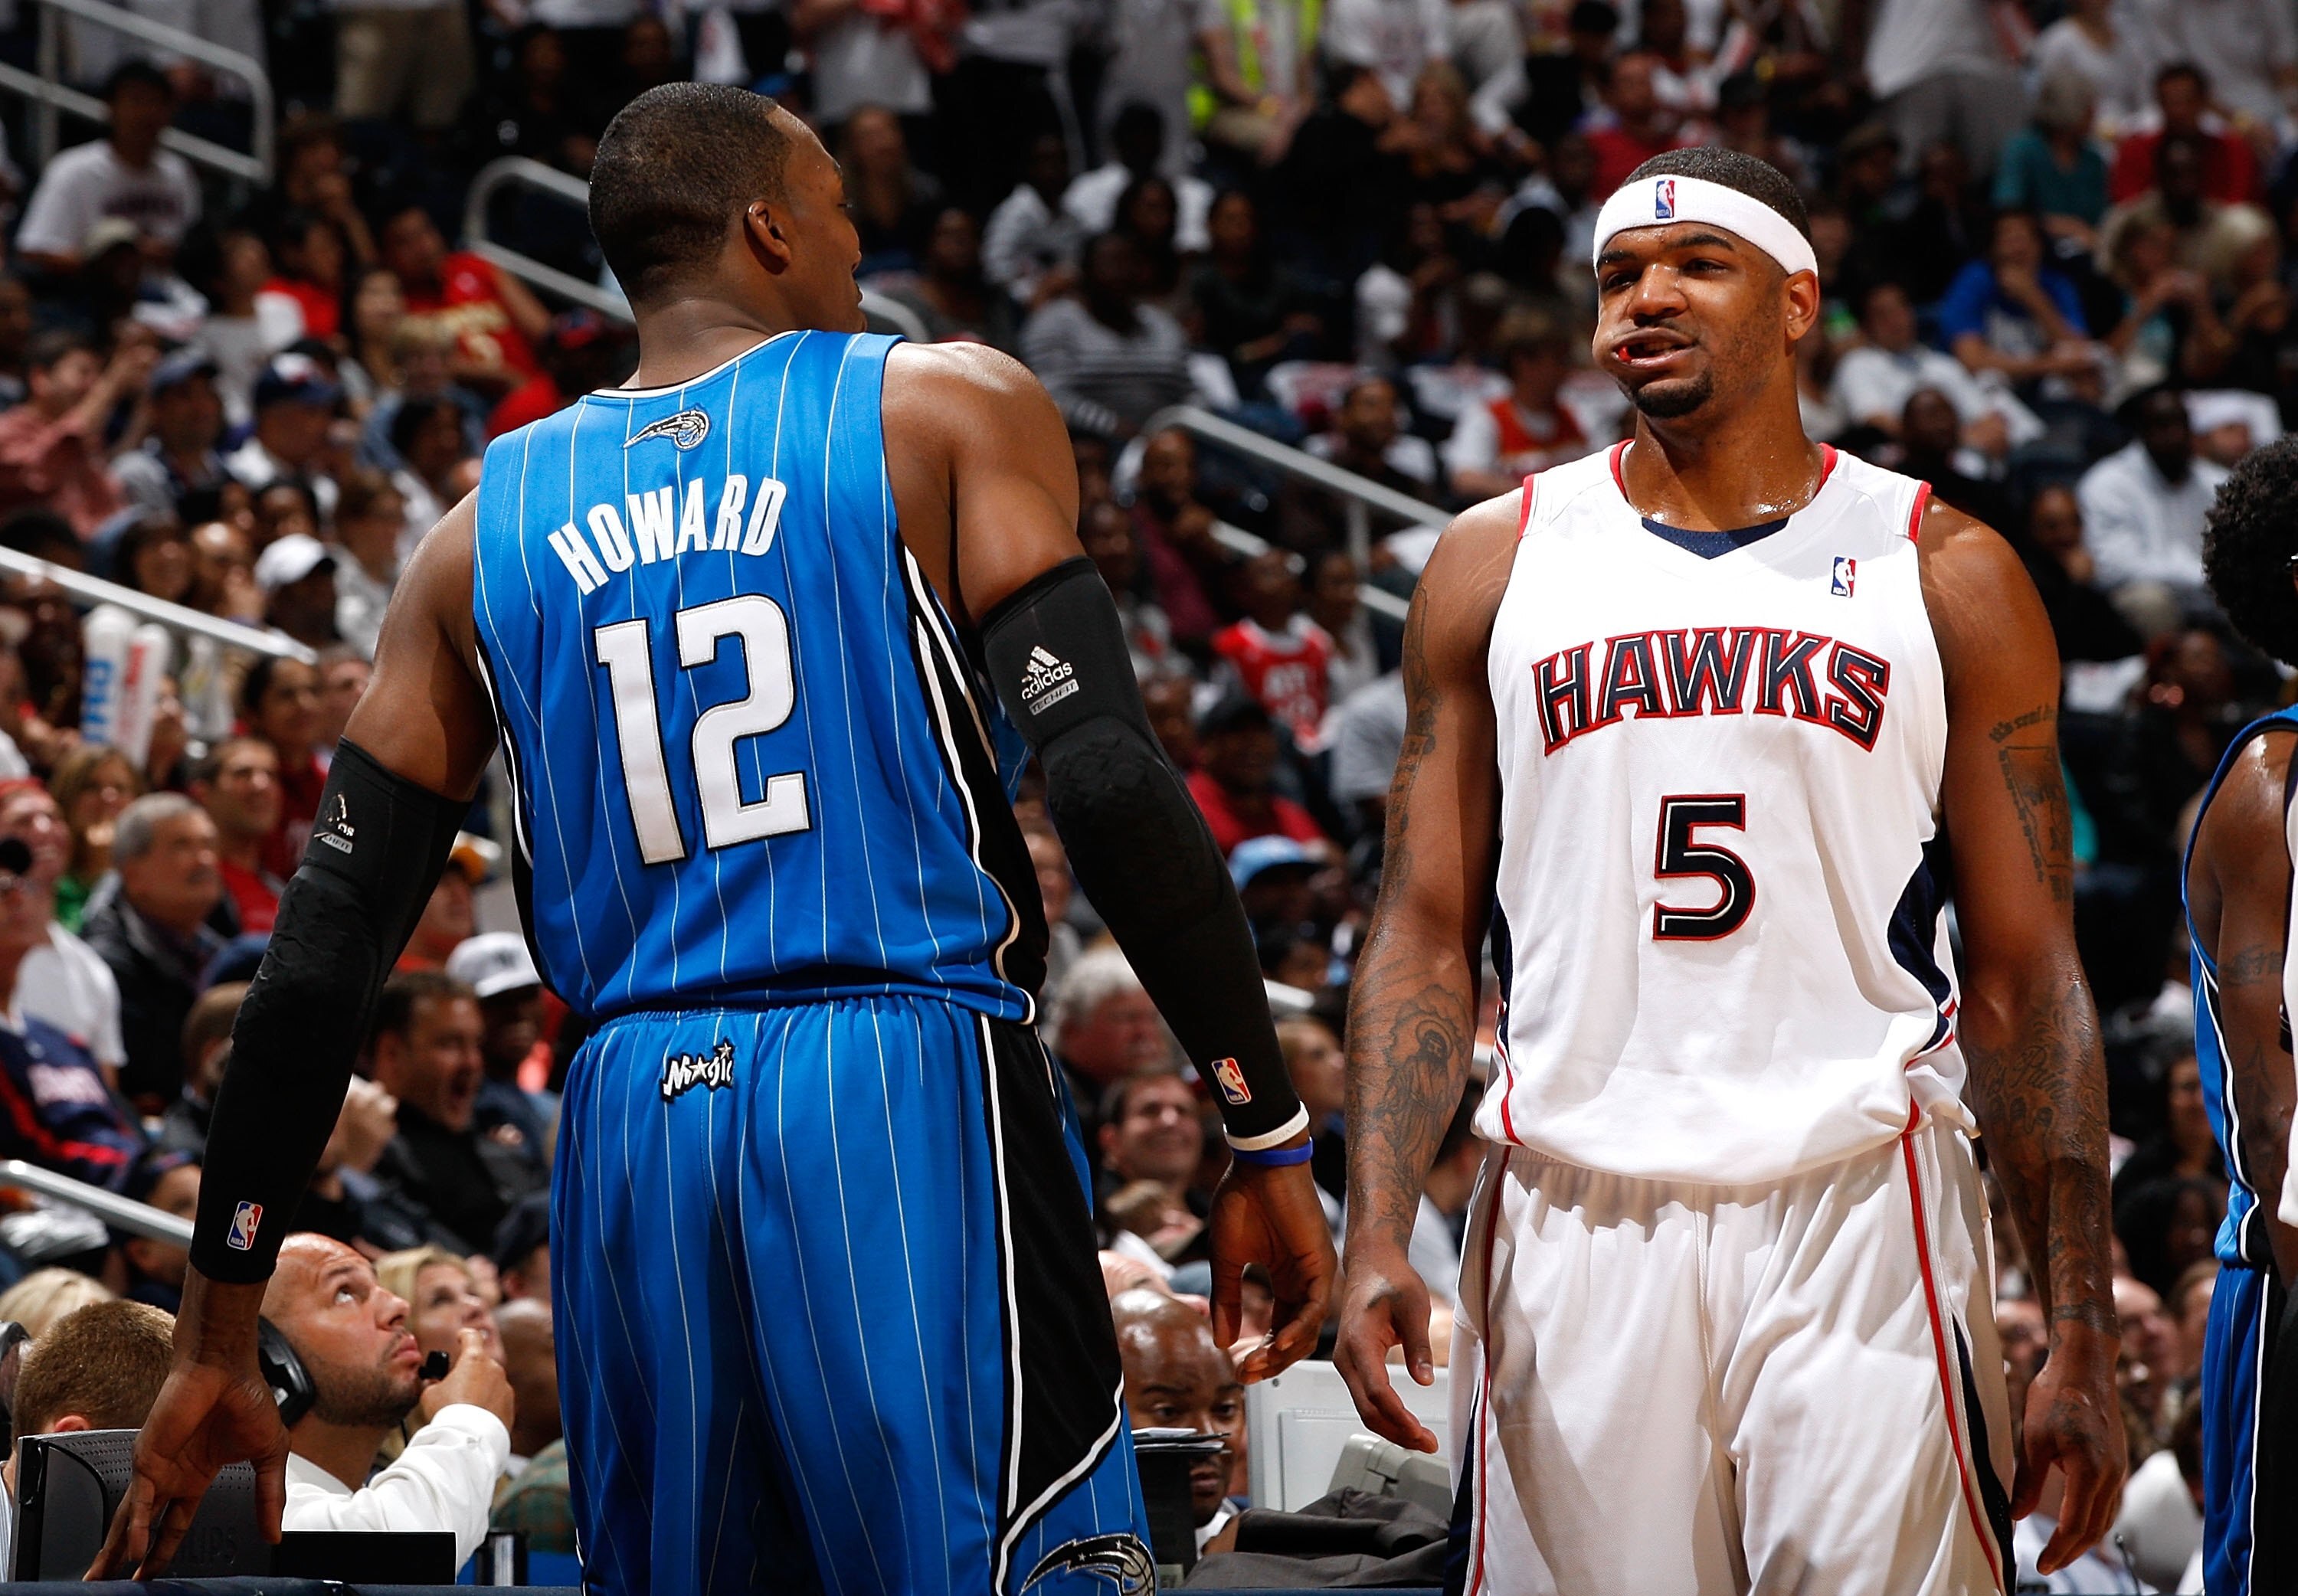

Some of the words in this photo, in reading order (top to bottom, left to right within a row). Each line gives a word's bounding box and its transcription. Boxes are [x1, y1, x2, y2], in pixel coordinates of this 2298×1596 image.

[547, 474, 786, 595] HOWARD
[594, 594, 810, 865] 12
[1021, 662, 1073, 700] adidas
[1532, 626, 1890, 756] HAWKS
[1653, 793, 1756, 940] 5
[231, 1236, 244, 1247] NBA
